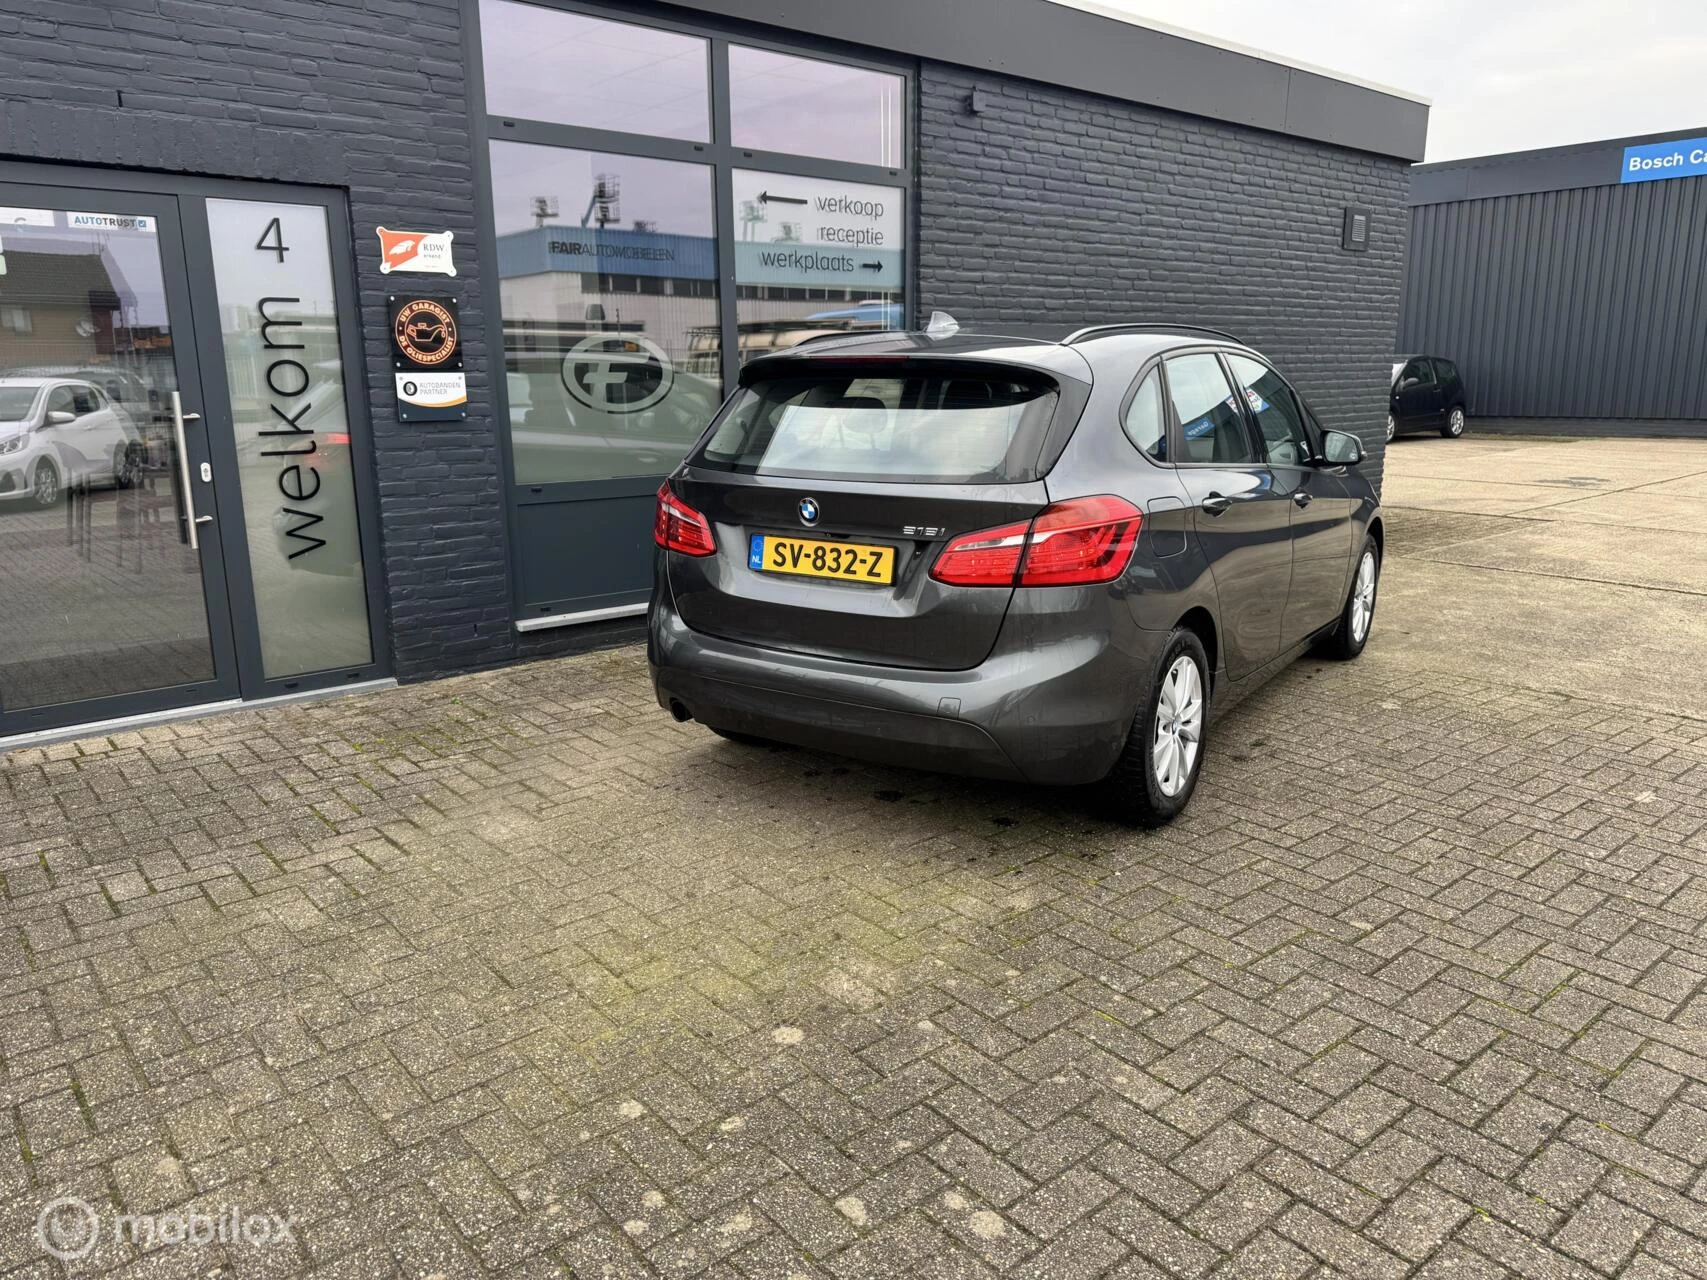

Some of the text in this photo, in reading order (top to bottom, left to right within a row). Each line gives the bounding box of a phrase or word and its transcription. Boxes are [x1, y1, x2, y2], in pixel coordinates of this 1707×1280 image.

[1629, 152, 1684, 171] Bosch
[816, 194, 884, 221] verkoop
[74, 215, 136, 228] AUTOTRUST
[255, 217, 290, 263] 4
[423, 243, 445, 252] RDW
[818, 226, 884, 248] receptie
[761, 250, 855, 273] werkplaats
[400, 303, 450, 322] UW GARAGIST
[399, 336, 454, 361] DE OLIESPECIALIST
[258, 296, 327, 560] welkom
[751, 542, 883, 578] NL SV-832-Z
